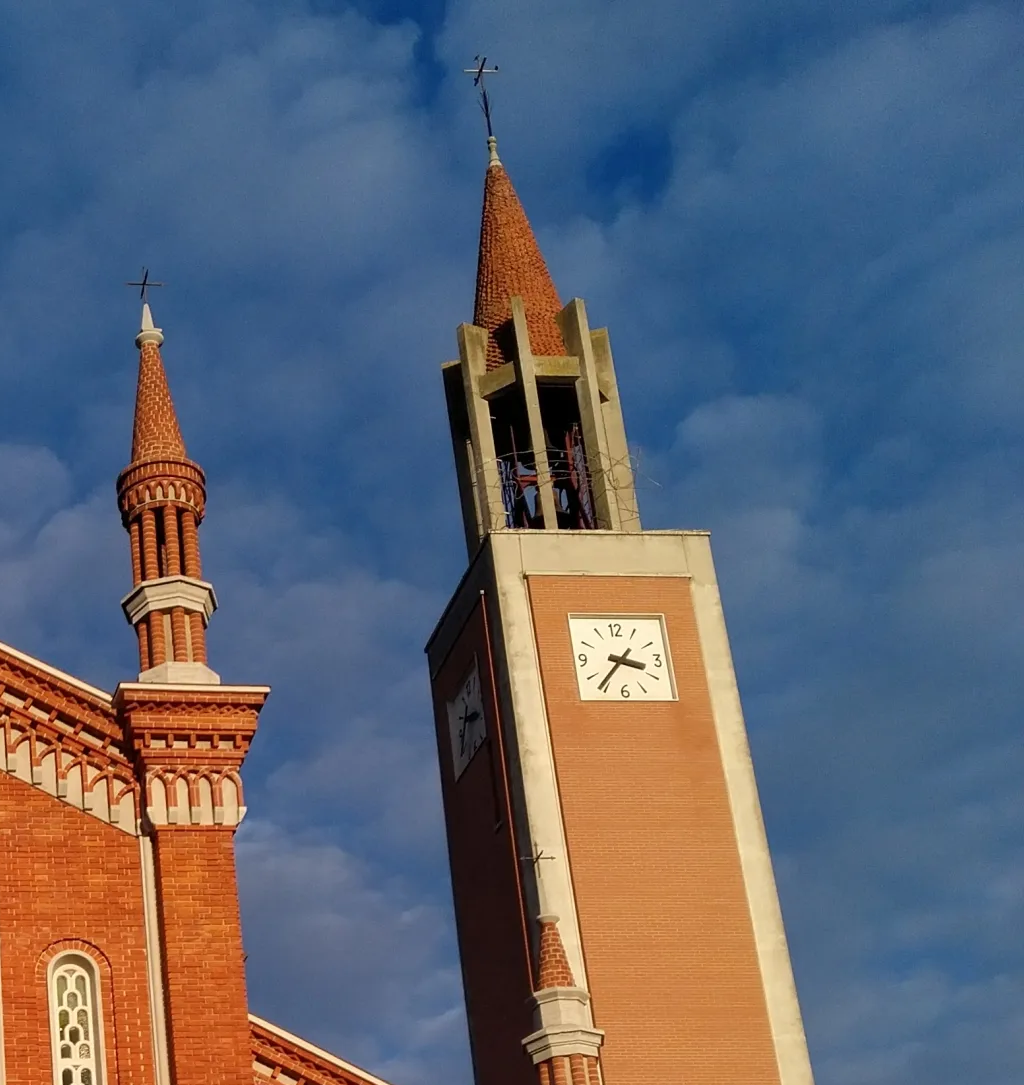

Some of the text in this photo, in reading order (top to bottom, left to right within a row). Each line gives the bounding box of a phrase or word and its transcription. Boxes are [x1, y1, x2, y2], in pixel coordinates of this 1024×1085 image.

[607, 623, 623, 638] 12
[578, 653, 588, 668] 9
[652, 653, 662, 668] 3
[620, 684, 630, 698] 6
